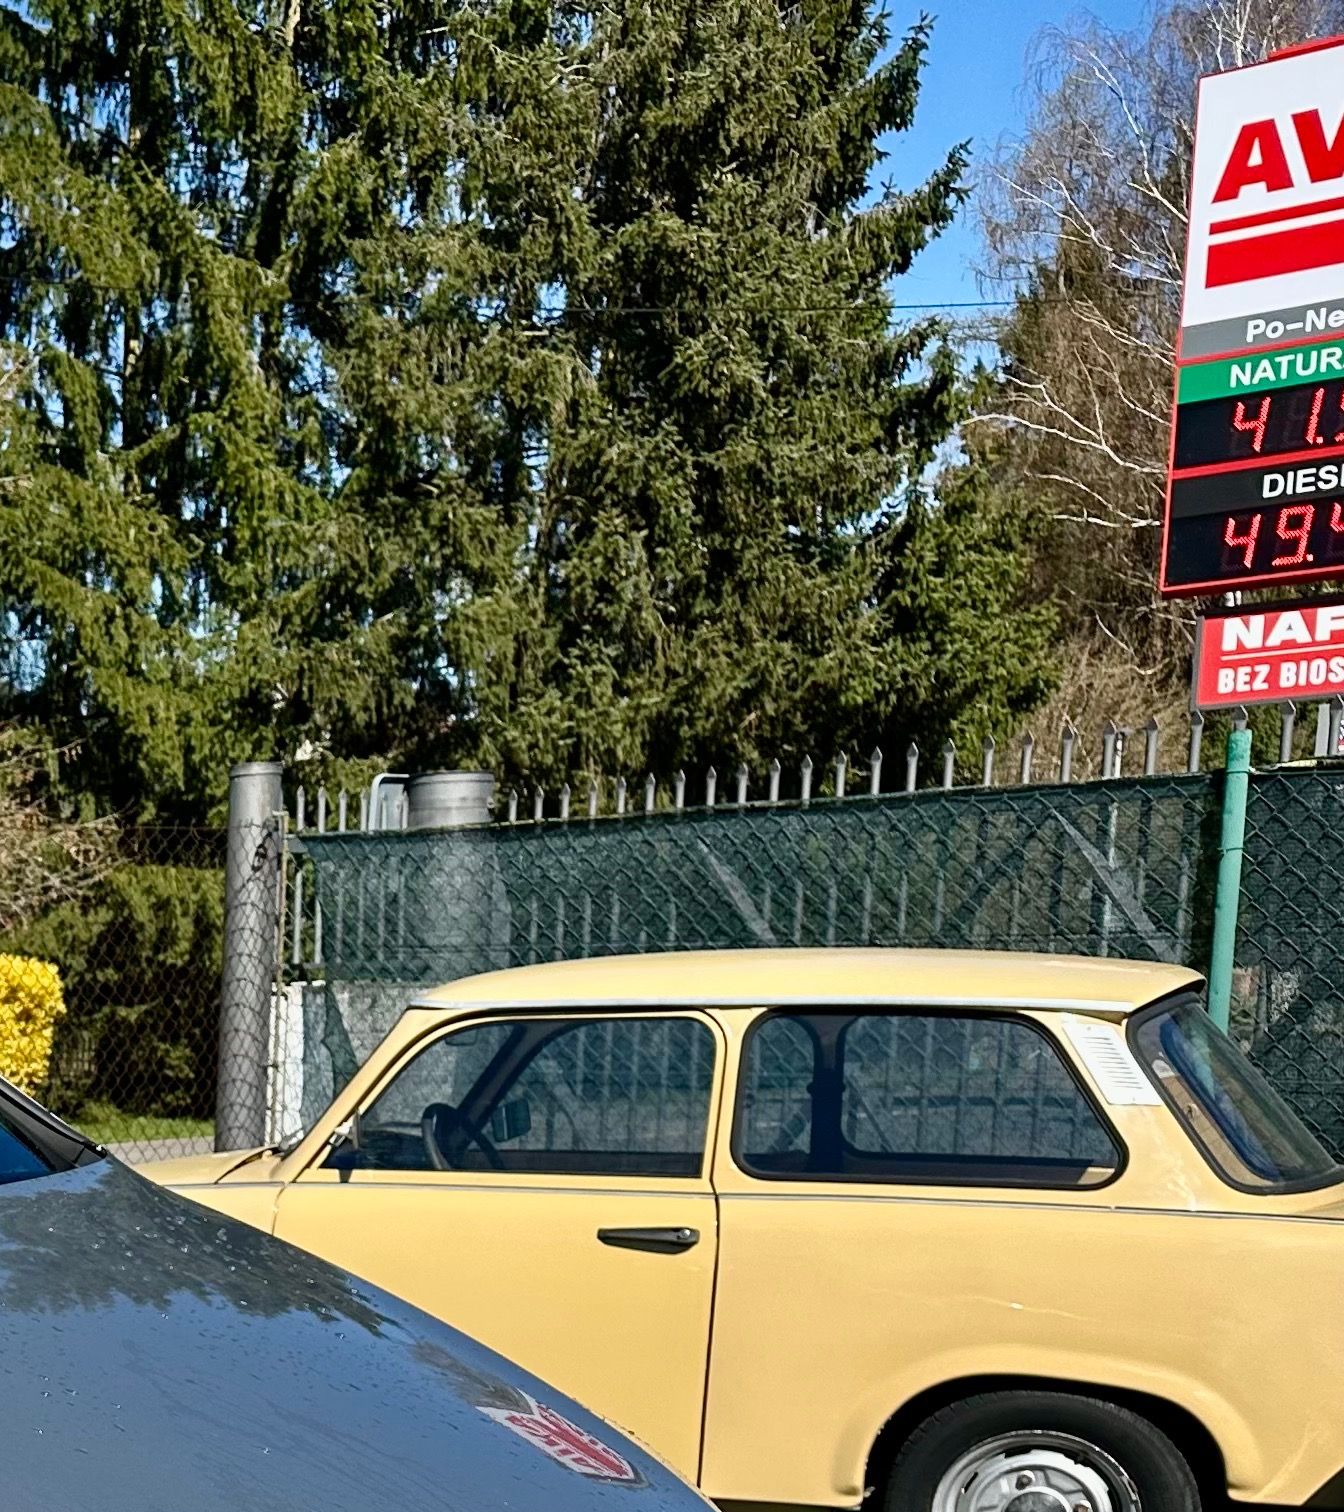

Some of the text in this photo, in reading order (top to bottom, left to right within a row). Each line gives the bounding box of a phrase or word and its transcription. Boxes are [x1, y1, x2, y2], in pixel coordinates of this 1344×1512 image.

[1229, 346, 1344, 388] NATUR
[1262, 463, 1344, 499] DIES
[1217, 664, 1271, 694] BEZ
